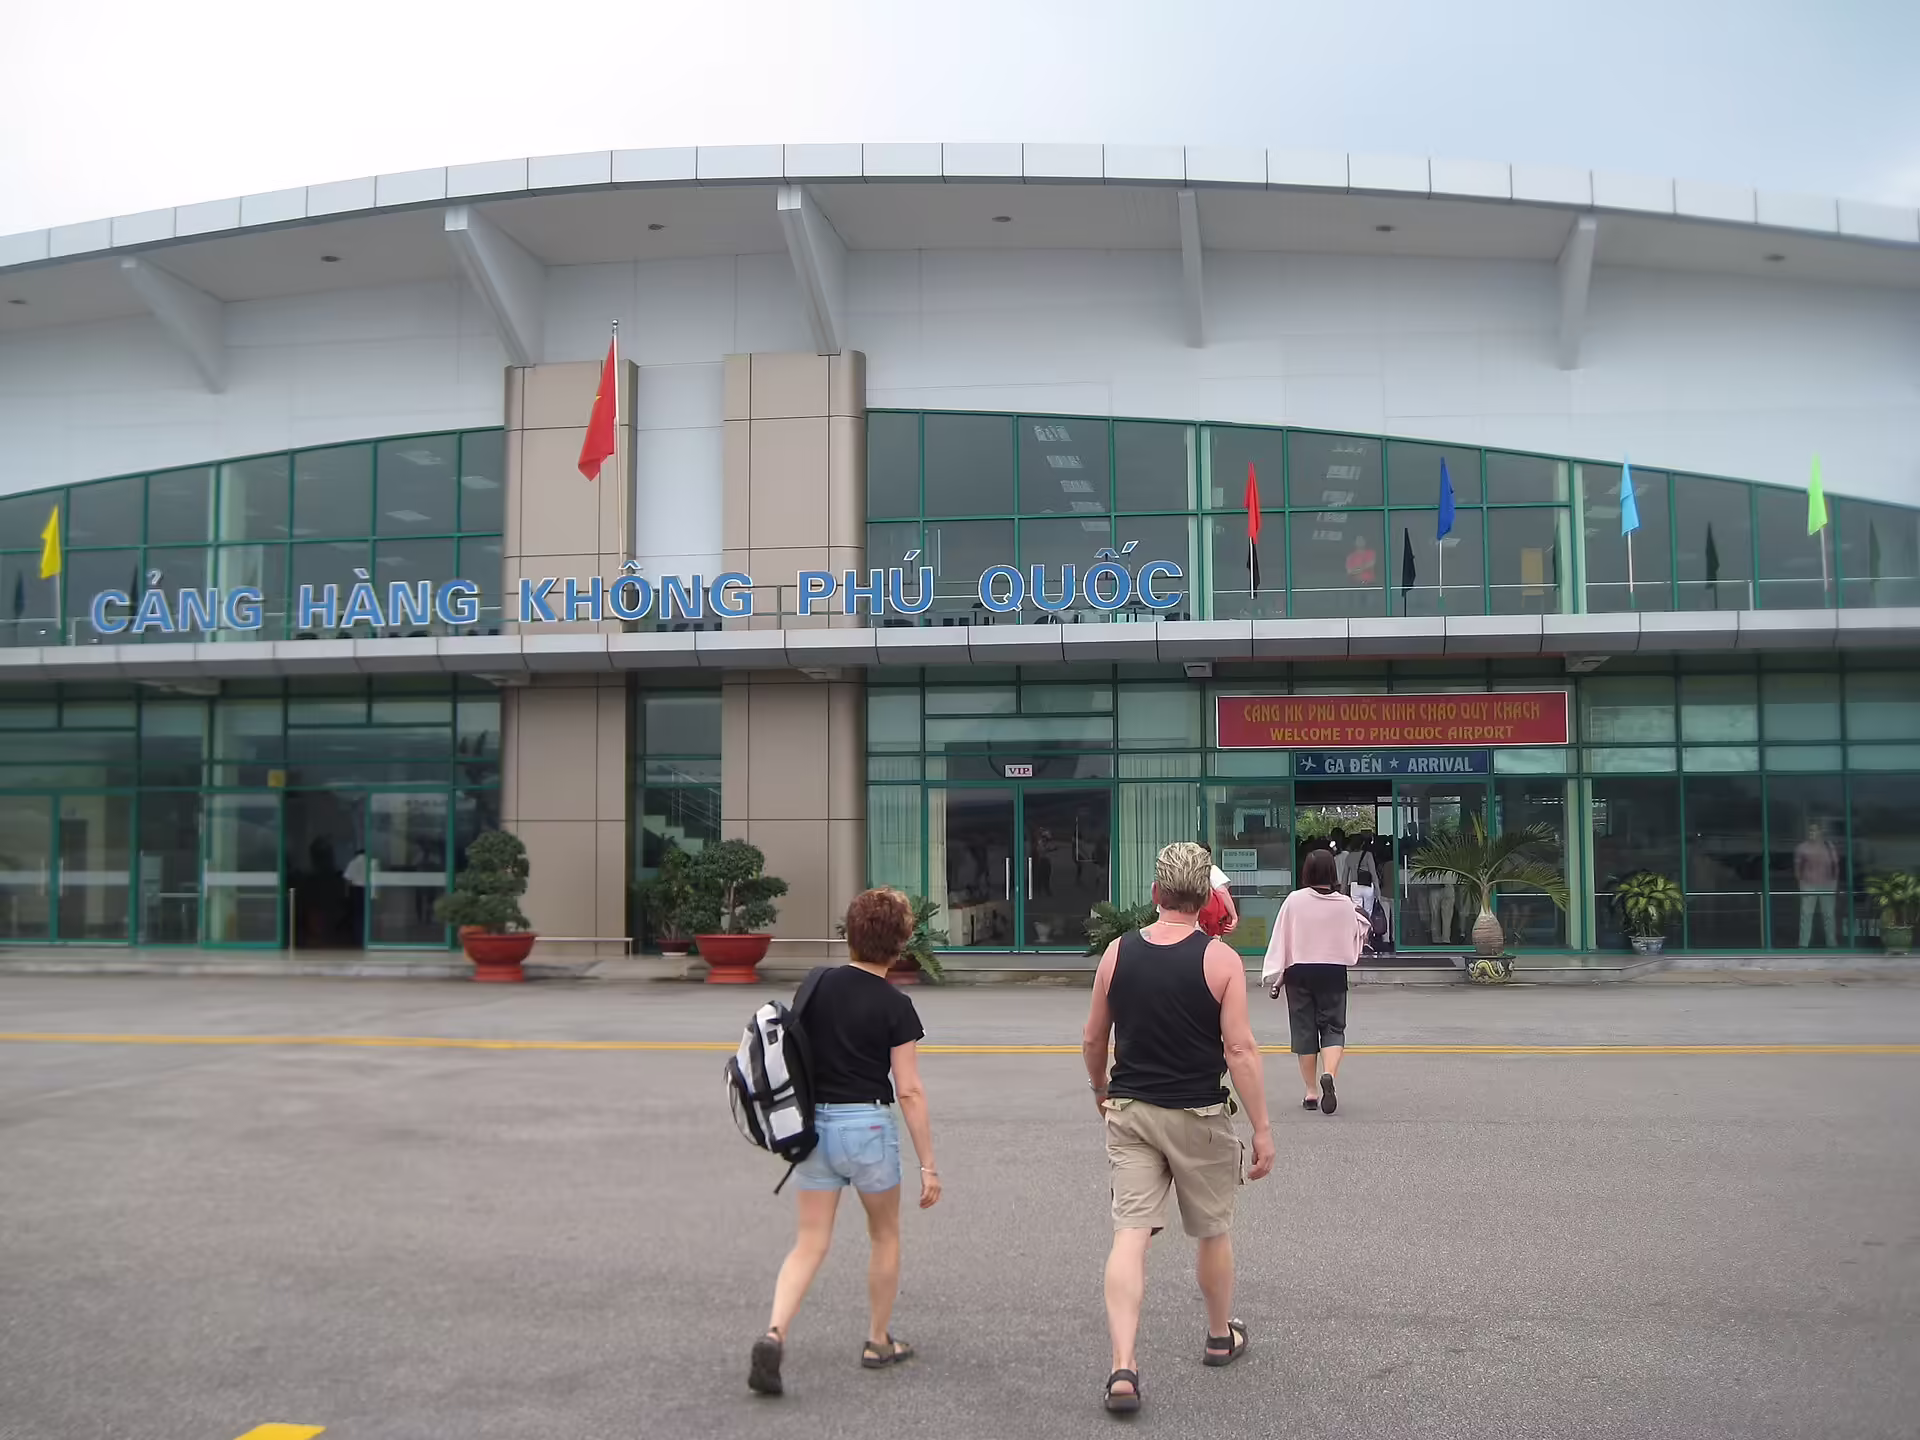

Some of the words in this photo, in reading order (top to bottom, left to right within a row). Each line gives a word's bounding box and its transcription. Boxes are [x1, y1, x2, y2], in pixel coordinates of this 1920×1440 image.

[91, 568, 265, 634] CẢNG
[298, 567, 481, 629] HÀNG
[518, 559, 754, 623] KHÔNG
[796, 549, 934, 616] PHÚ
[978, 540, 1184, 613] QUỐC
[1270, 727, 1341, 741] WELCOME
[1345, 727, 1365, 741] TO
[1447, 725, 1514, 740] AIRPORT
[1008, 767, 1030, 775] VIP
[1324, 757, 1345, 773] GA
[1407, 756, 1473, 773] ARRIVAL
